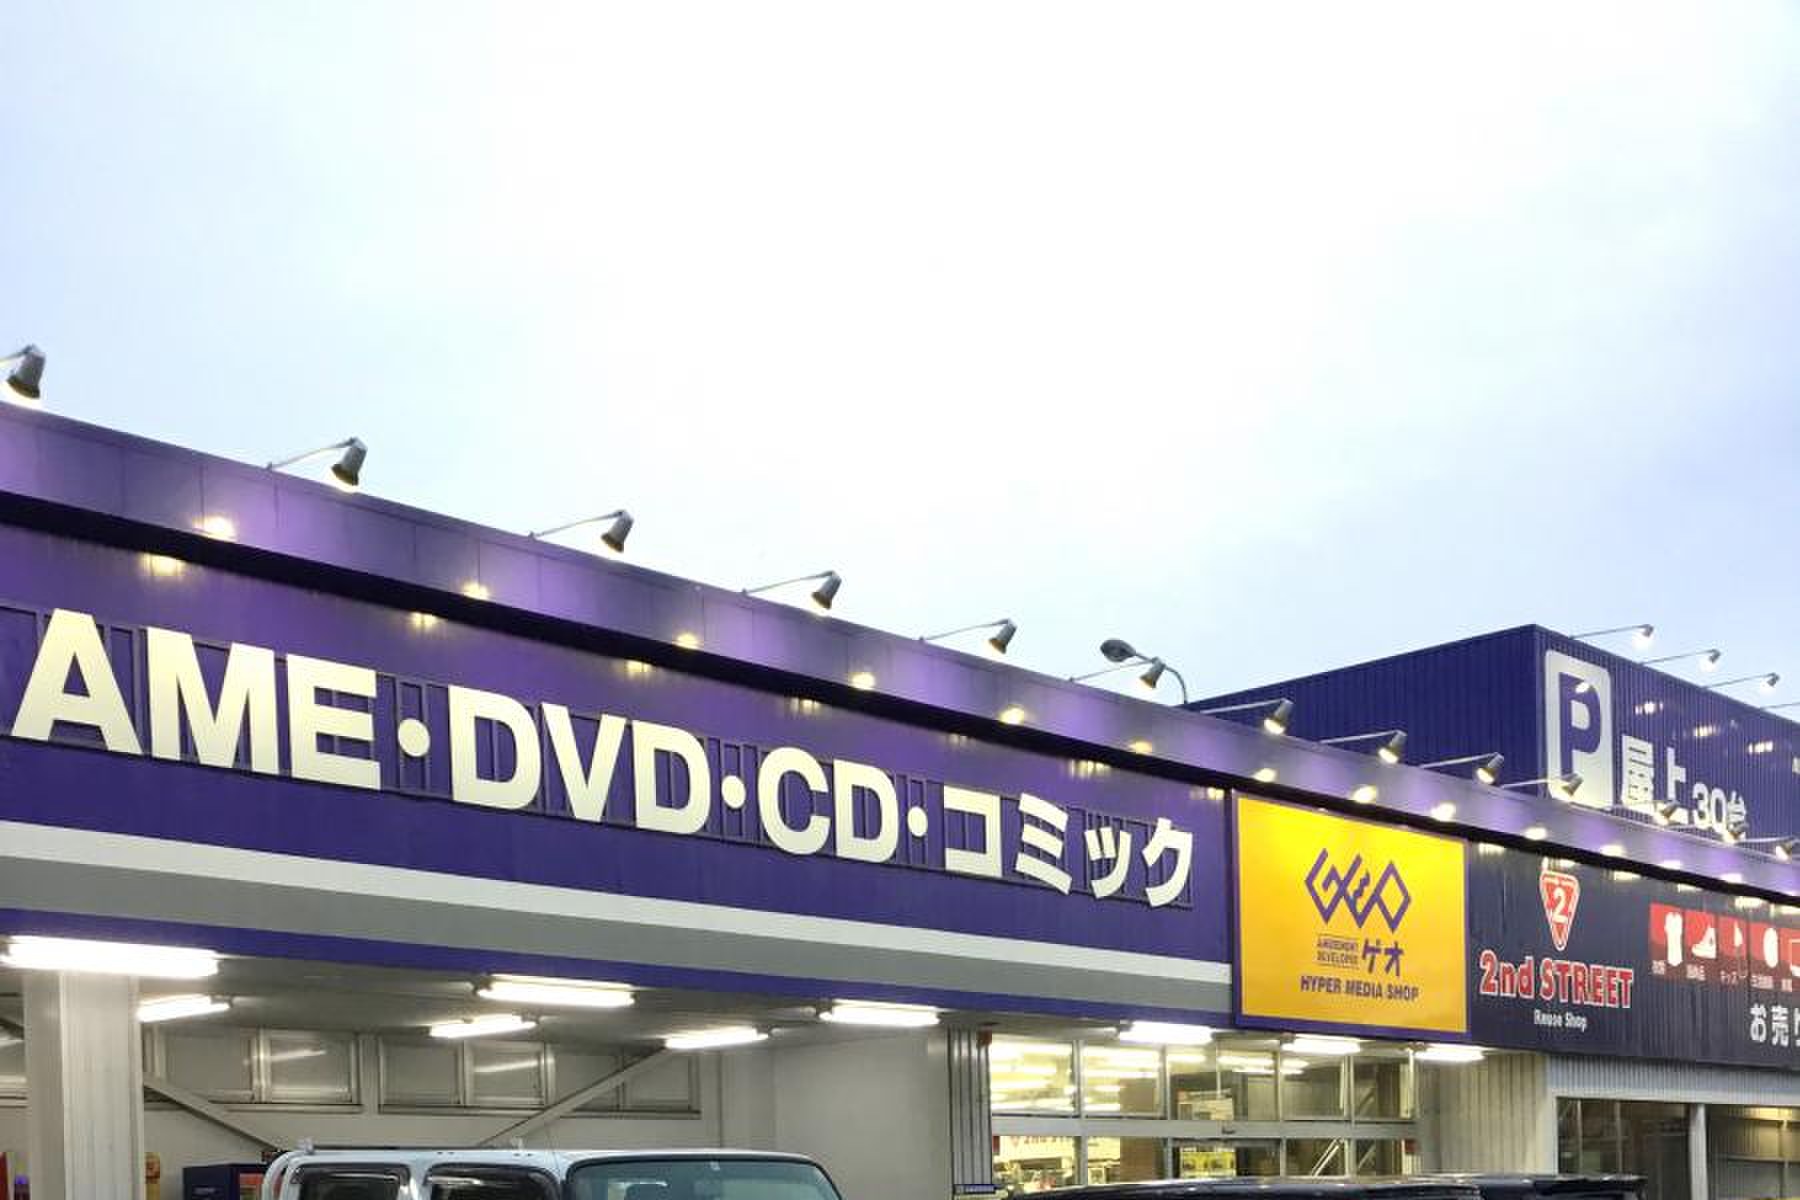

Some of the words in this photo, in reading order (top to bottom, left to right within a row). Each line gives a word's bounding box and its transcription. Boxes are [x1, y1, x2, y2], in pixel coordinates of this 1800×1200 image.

[1361, 938, 1404, 977] ゲオ
[1300, 975, 1342, 994] HYPER
[1345, 978, 1383, 999] MEDIA
[1387, 983, 1420, 1001] SHOP
[1479, 949, 1535, 999] 2nd
[1540, 957, 1634, 1009] STREET
[1564, 1010, 1587, 1033] Shop
